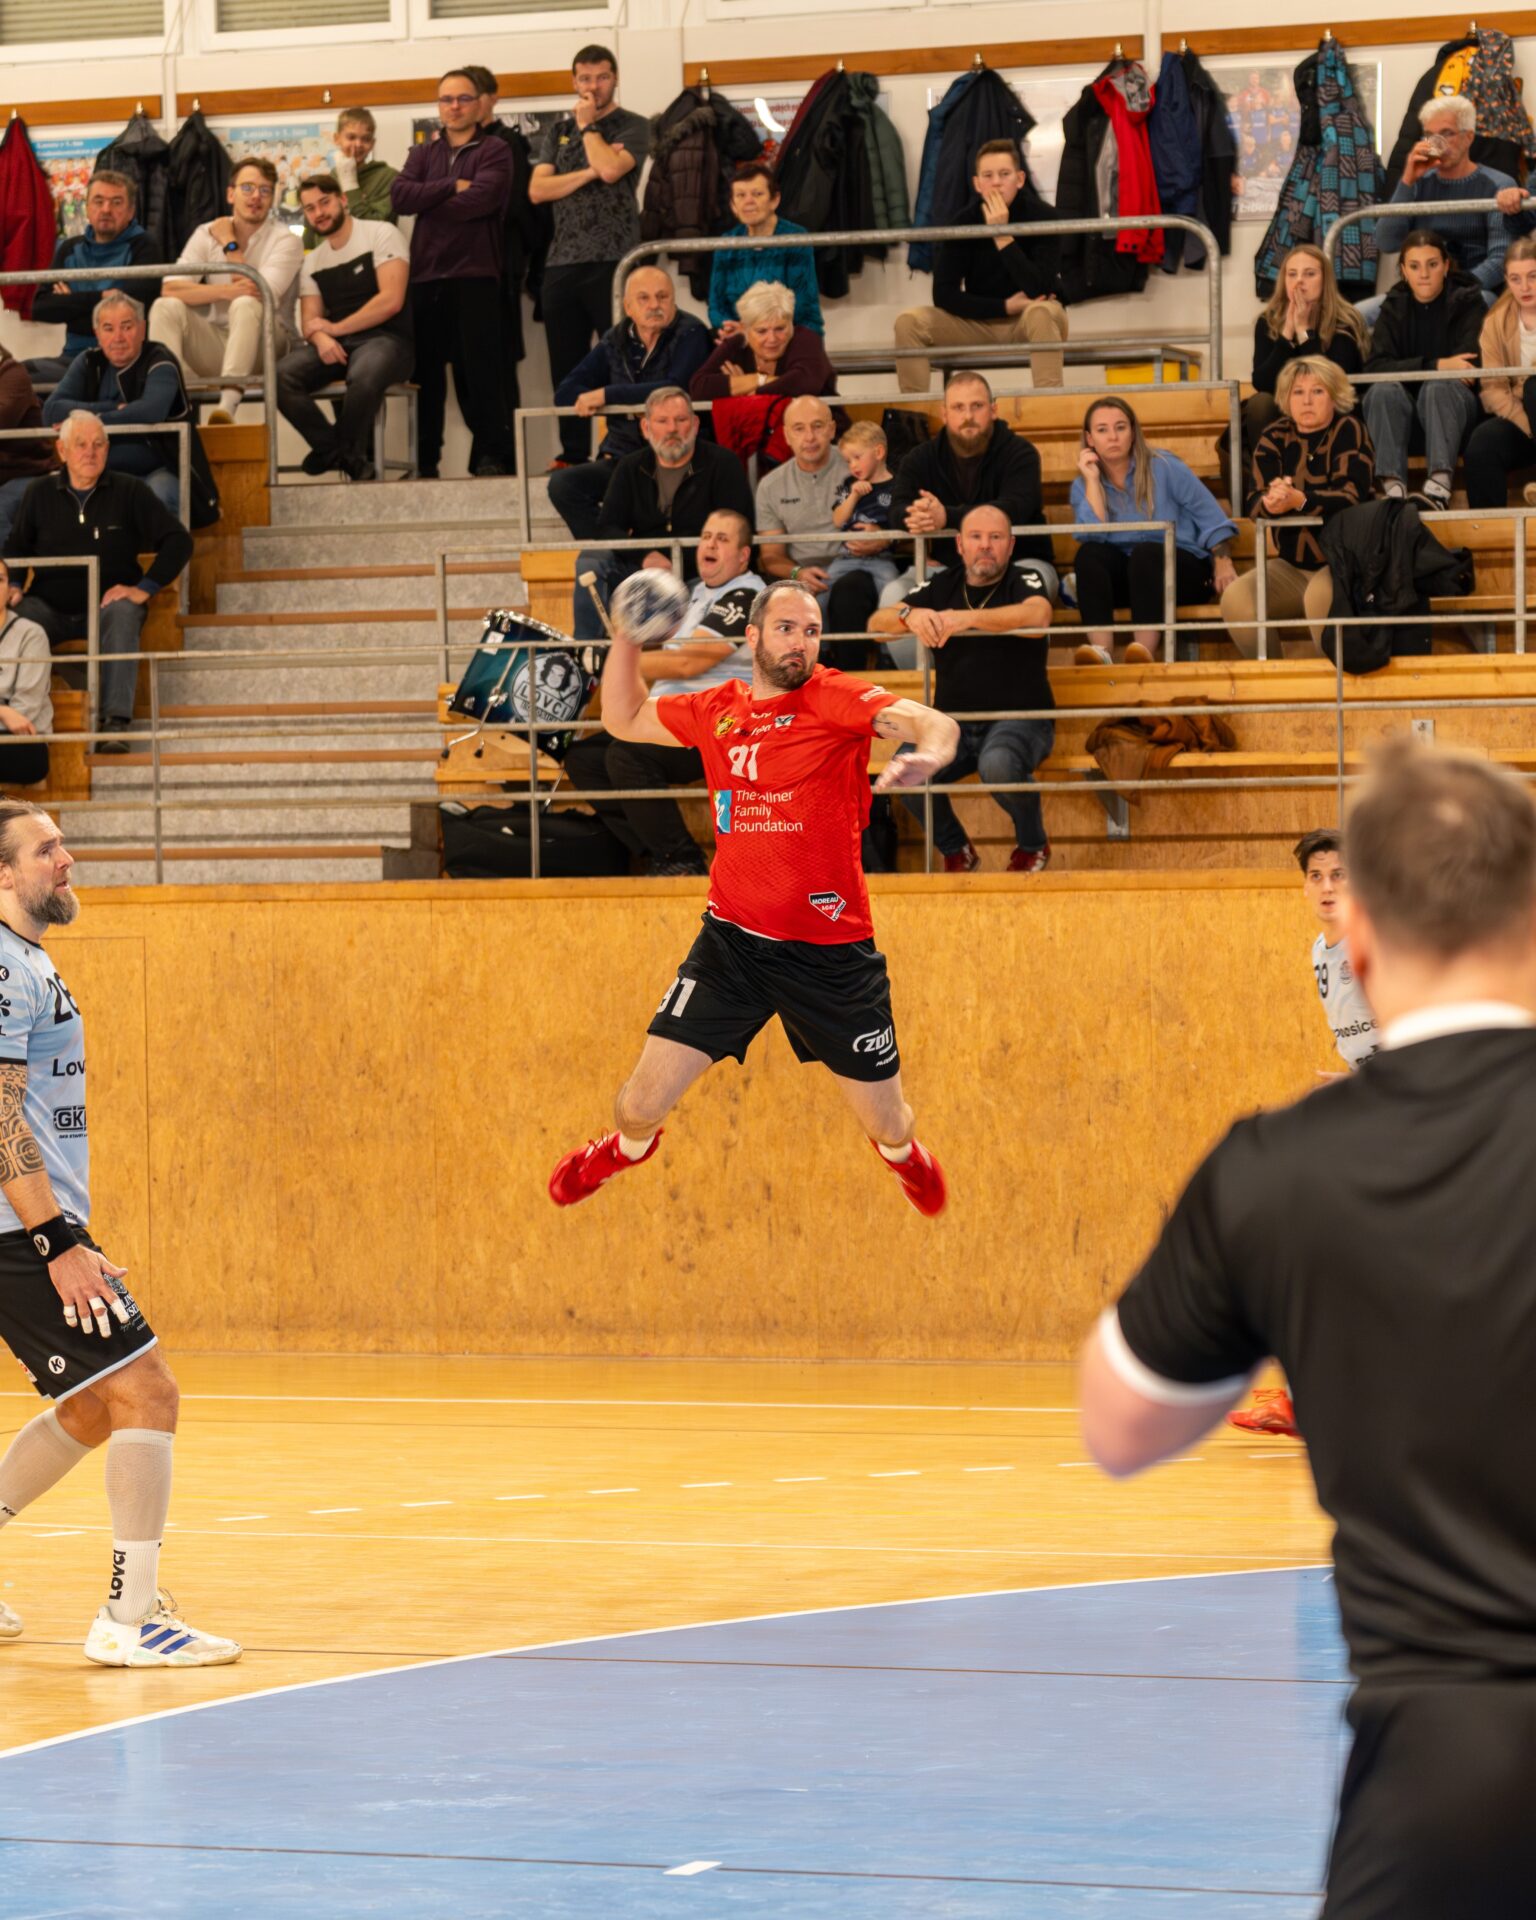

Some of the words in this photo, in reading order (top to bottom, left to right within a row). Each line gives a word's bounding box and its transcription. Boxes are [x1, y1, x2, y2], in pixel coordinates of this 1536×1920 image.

[728, 742, 761, 781] 91
[736, 790, 757, 801] The
[734, 804, 772, 818] Family
[734, 820, 803, 832] Foundation
[812, 896, 839, 904] MOREAU
[52, 1058, 86, 1077] Lov
[57, 1110, 87, 1128] GK
[109, 1549, 126, 1601] LOVCI
